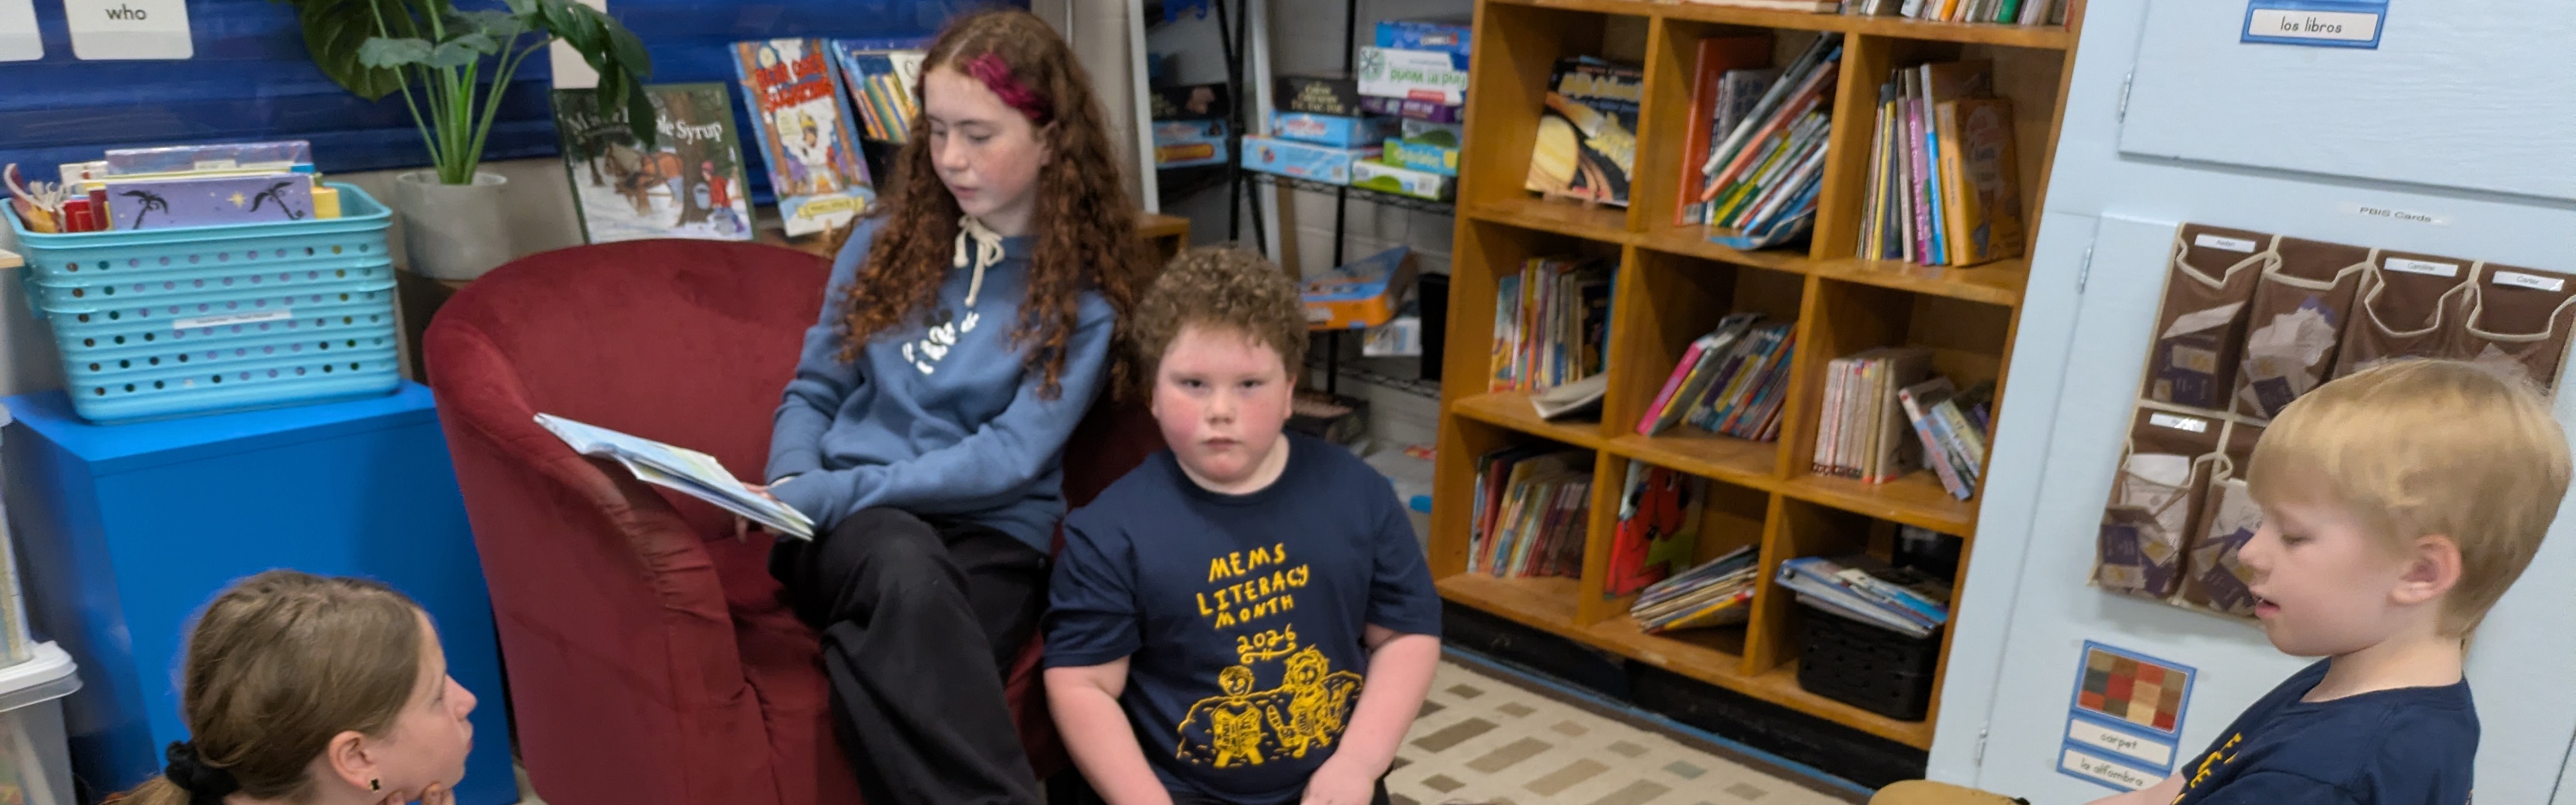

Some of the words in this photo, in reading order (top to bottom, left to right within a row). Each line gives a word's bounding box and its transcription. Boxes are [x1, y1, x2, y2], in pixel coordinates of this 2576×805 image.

[105, 3, 147, 20] who
[2281, 16, 2299, 31] los
[2304, 16, 2342, 33] libros
[675, 120, 723, 145] Syrup
[2360, 207, 2390, 217] PBIS
[2394, 211, 2432, 222] Cards
[1208, 541, 1286, 583] MEMS
[1196, 563, 1310, 617] LITERACY
[1214, 593, 1295, 631] MONTH
[1236, 622, 1297, 655] 2026
[2100, 733, 2138, 751] carpet
[2080, 758, 2090, 770] la
[2093, 764, 2144, 787] alfombra
